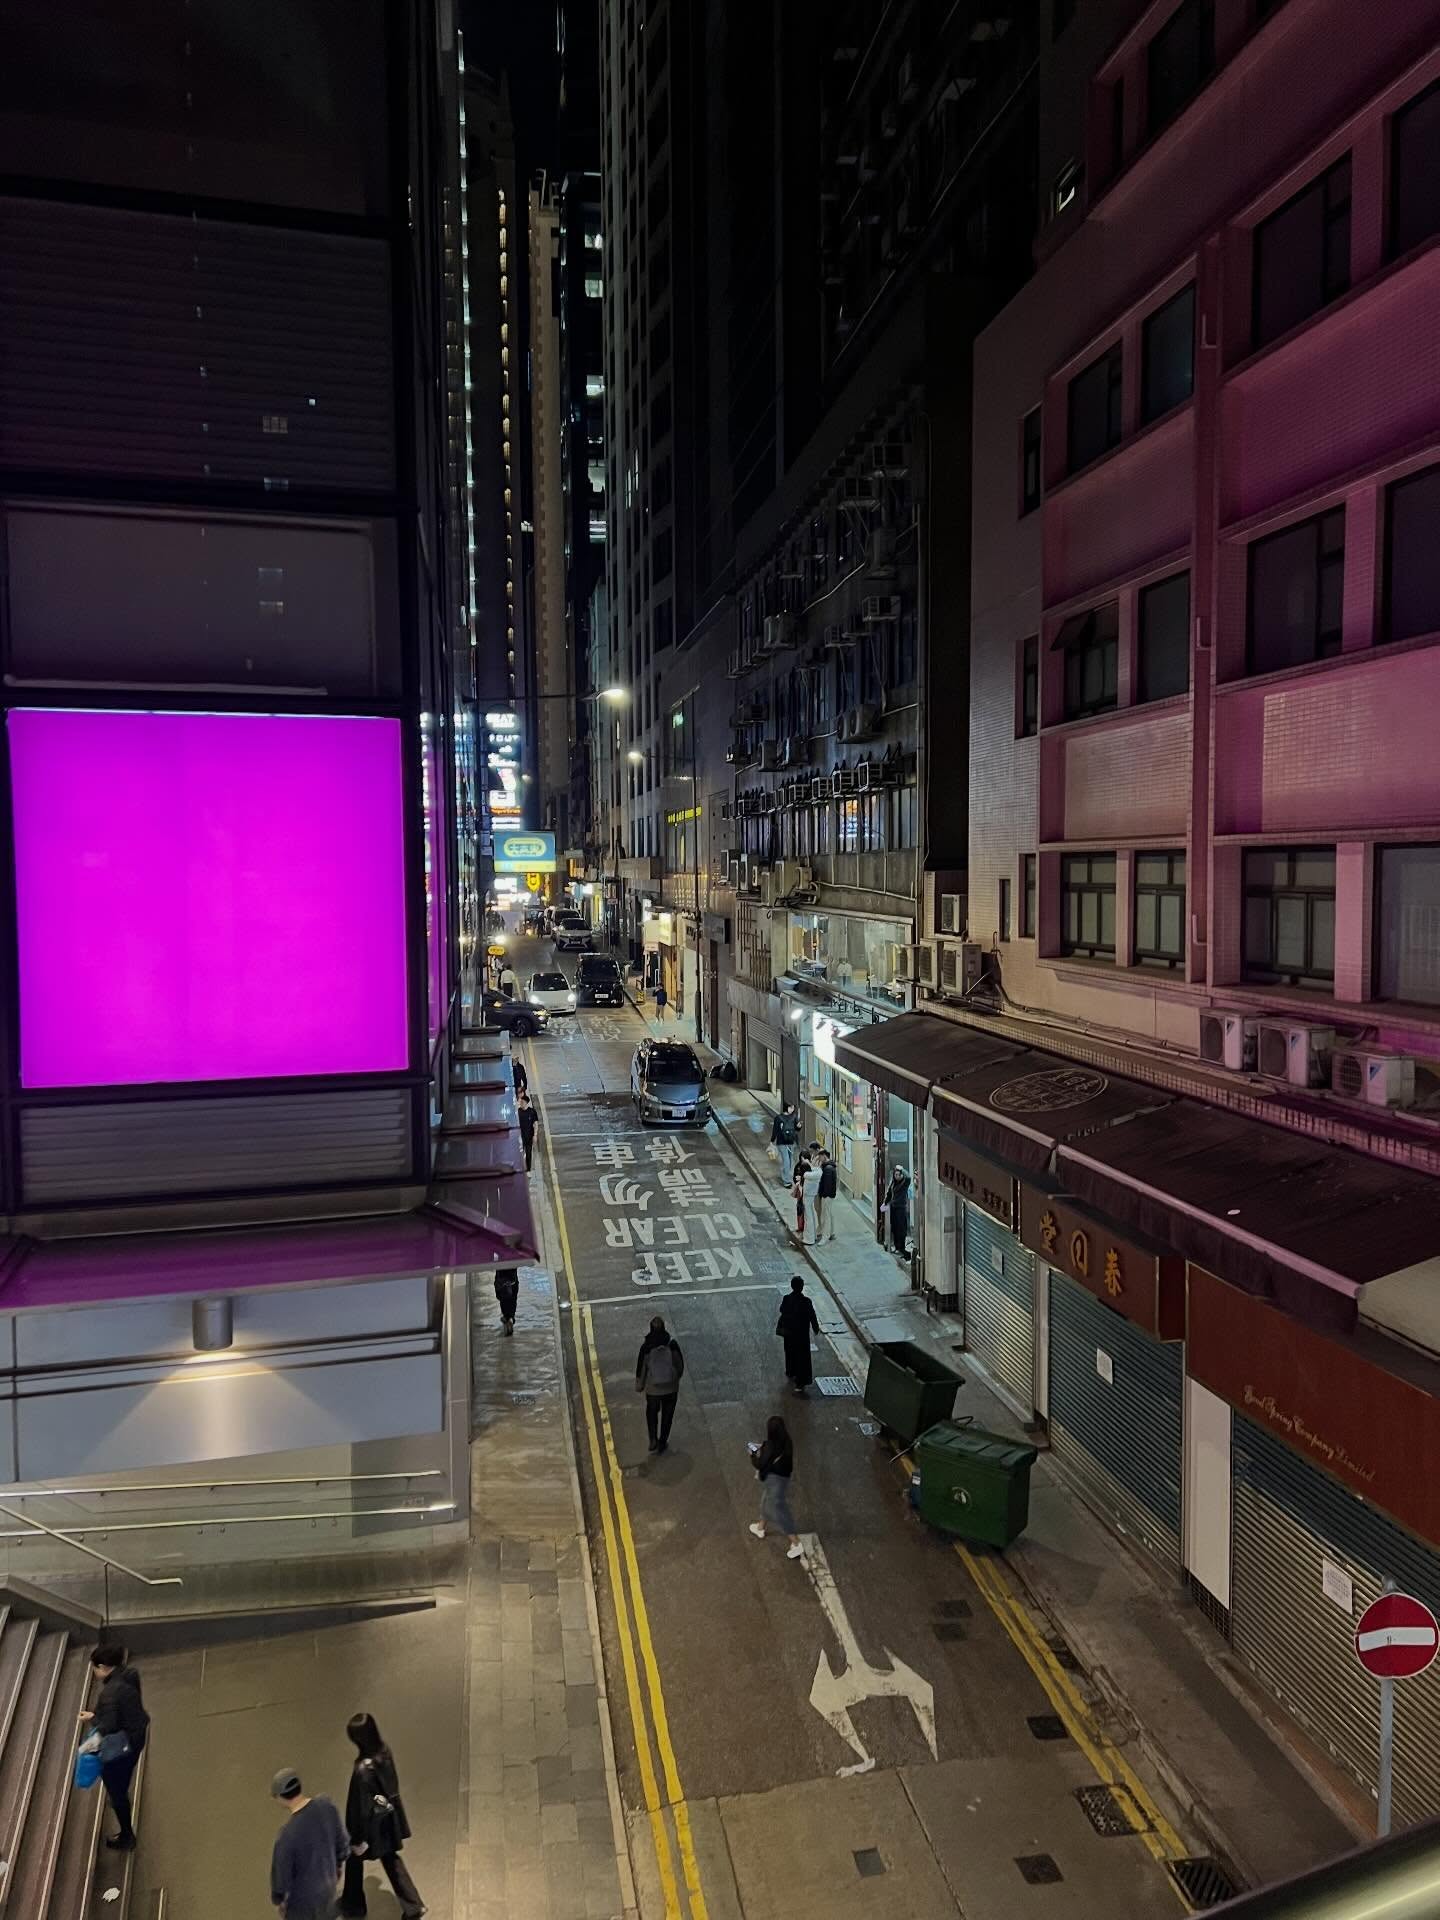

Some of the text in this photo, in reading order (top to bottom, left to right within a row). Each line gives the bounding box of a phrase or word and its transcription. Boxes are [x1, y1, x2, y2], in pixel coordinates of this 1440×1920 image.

[602, 1213, 746, 1248] CLEAR
[632, 1247, 753, 1286] KEEP
[1293, 1415, 1335, 1460] Company
[1336, 1444, 1376, 1482] Limited
